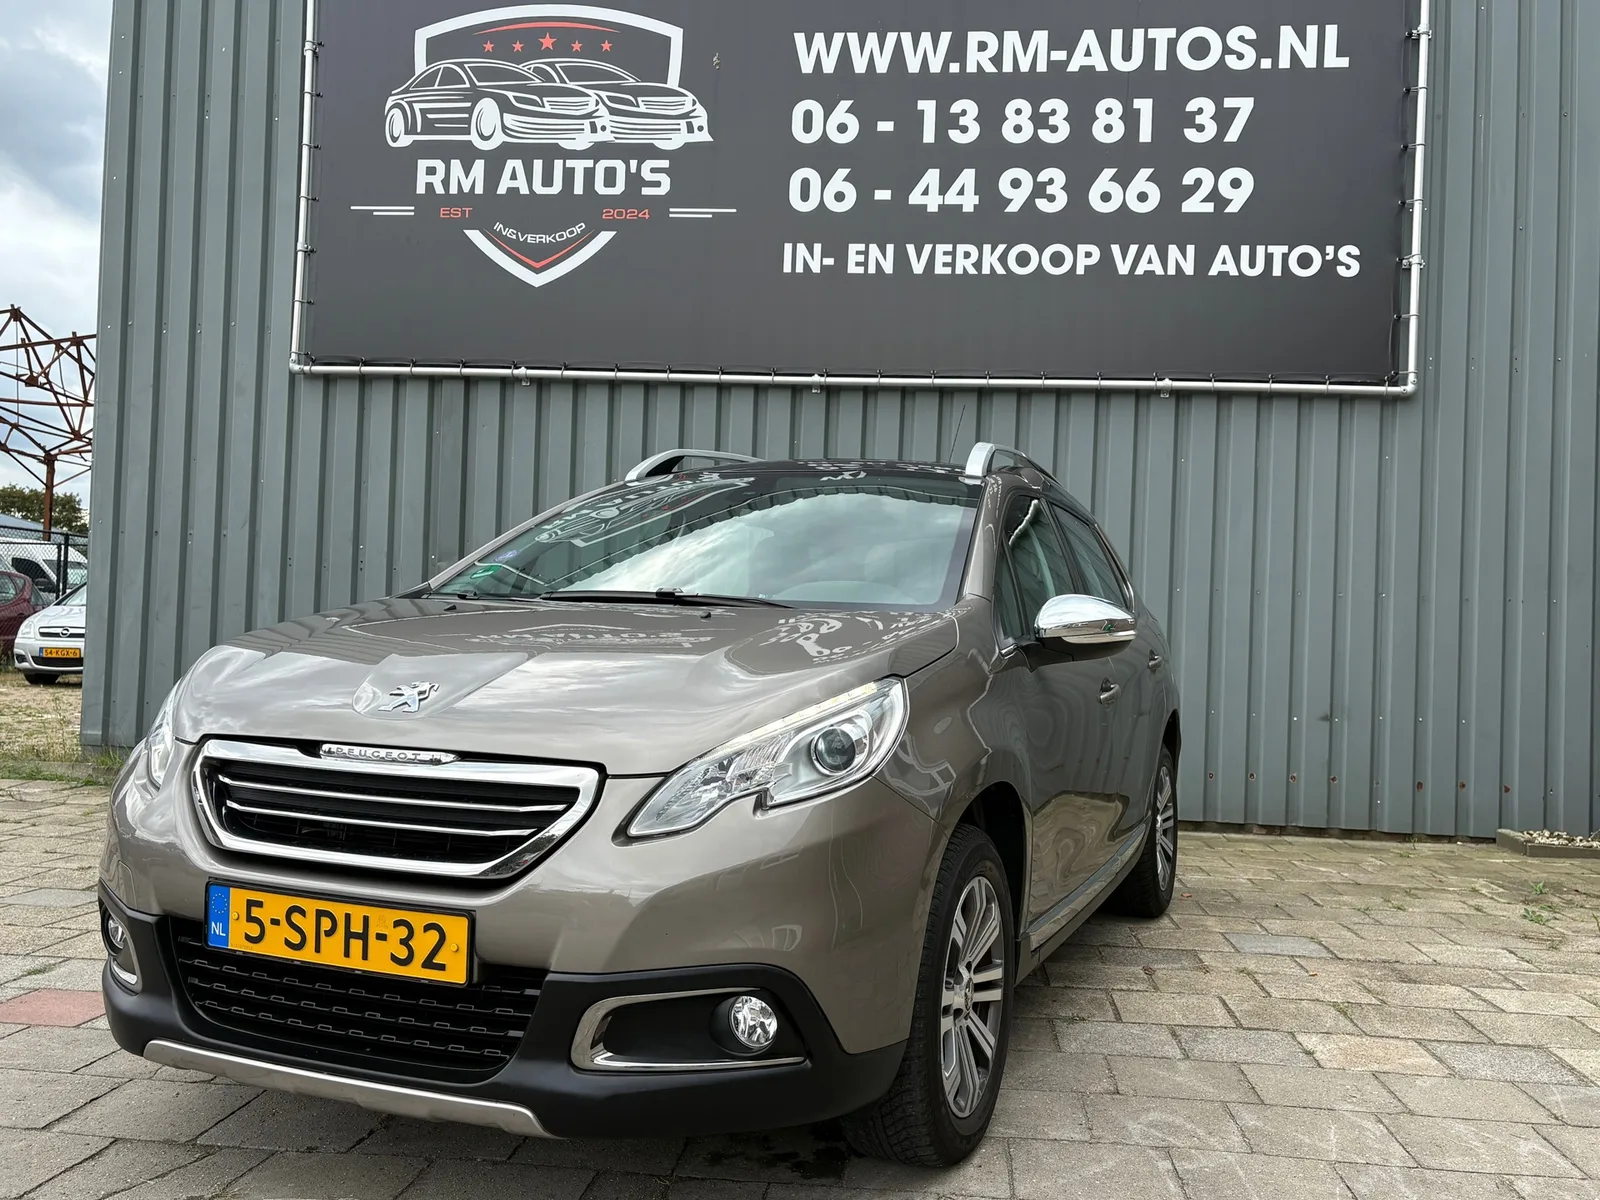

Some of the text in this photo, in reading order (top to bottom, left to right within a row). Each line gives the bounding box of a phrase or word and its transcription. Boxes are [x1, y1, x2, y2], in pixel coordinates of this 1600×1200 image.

[793, 24, 1350, 74] WWW.RM-AUTOS.NL
[791, 99, 860, 144] 06
[916, 99, 981, 144] 13
[1001, 98, 1071, 144] 83
[1091, 97, 1154, 144] 81
[1183, 96, 1255, 144] 37
[415, 158, 671, 196] RM AUTO'S
[788, 167, 857, 213] 06
[908, 168, 980, 213] 44
[998, 167, 1068, 214] 93
[1088, 167, 1161, 214] 66
[1181, 166, 1255, 213] 29
[439, 207, 472, 219] EST
[602, 208, 650, 220] 2024
[782, 242, 1361, 278] IN- EN VERKOOP VAN AUTO'S
[335, 746, 421, 762] PEUGEOT
[211, 921, 226, 937] NL
[244, 898, 447, 972] 5-SPH-32
